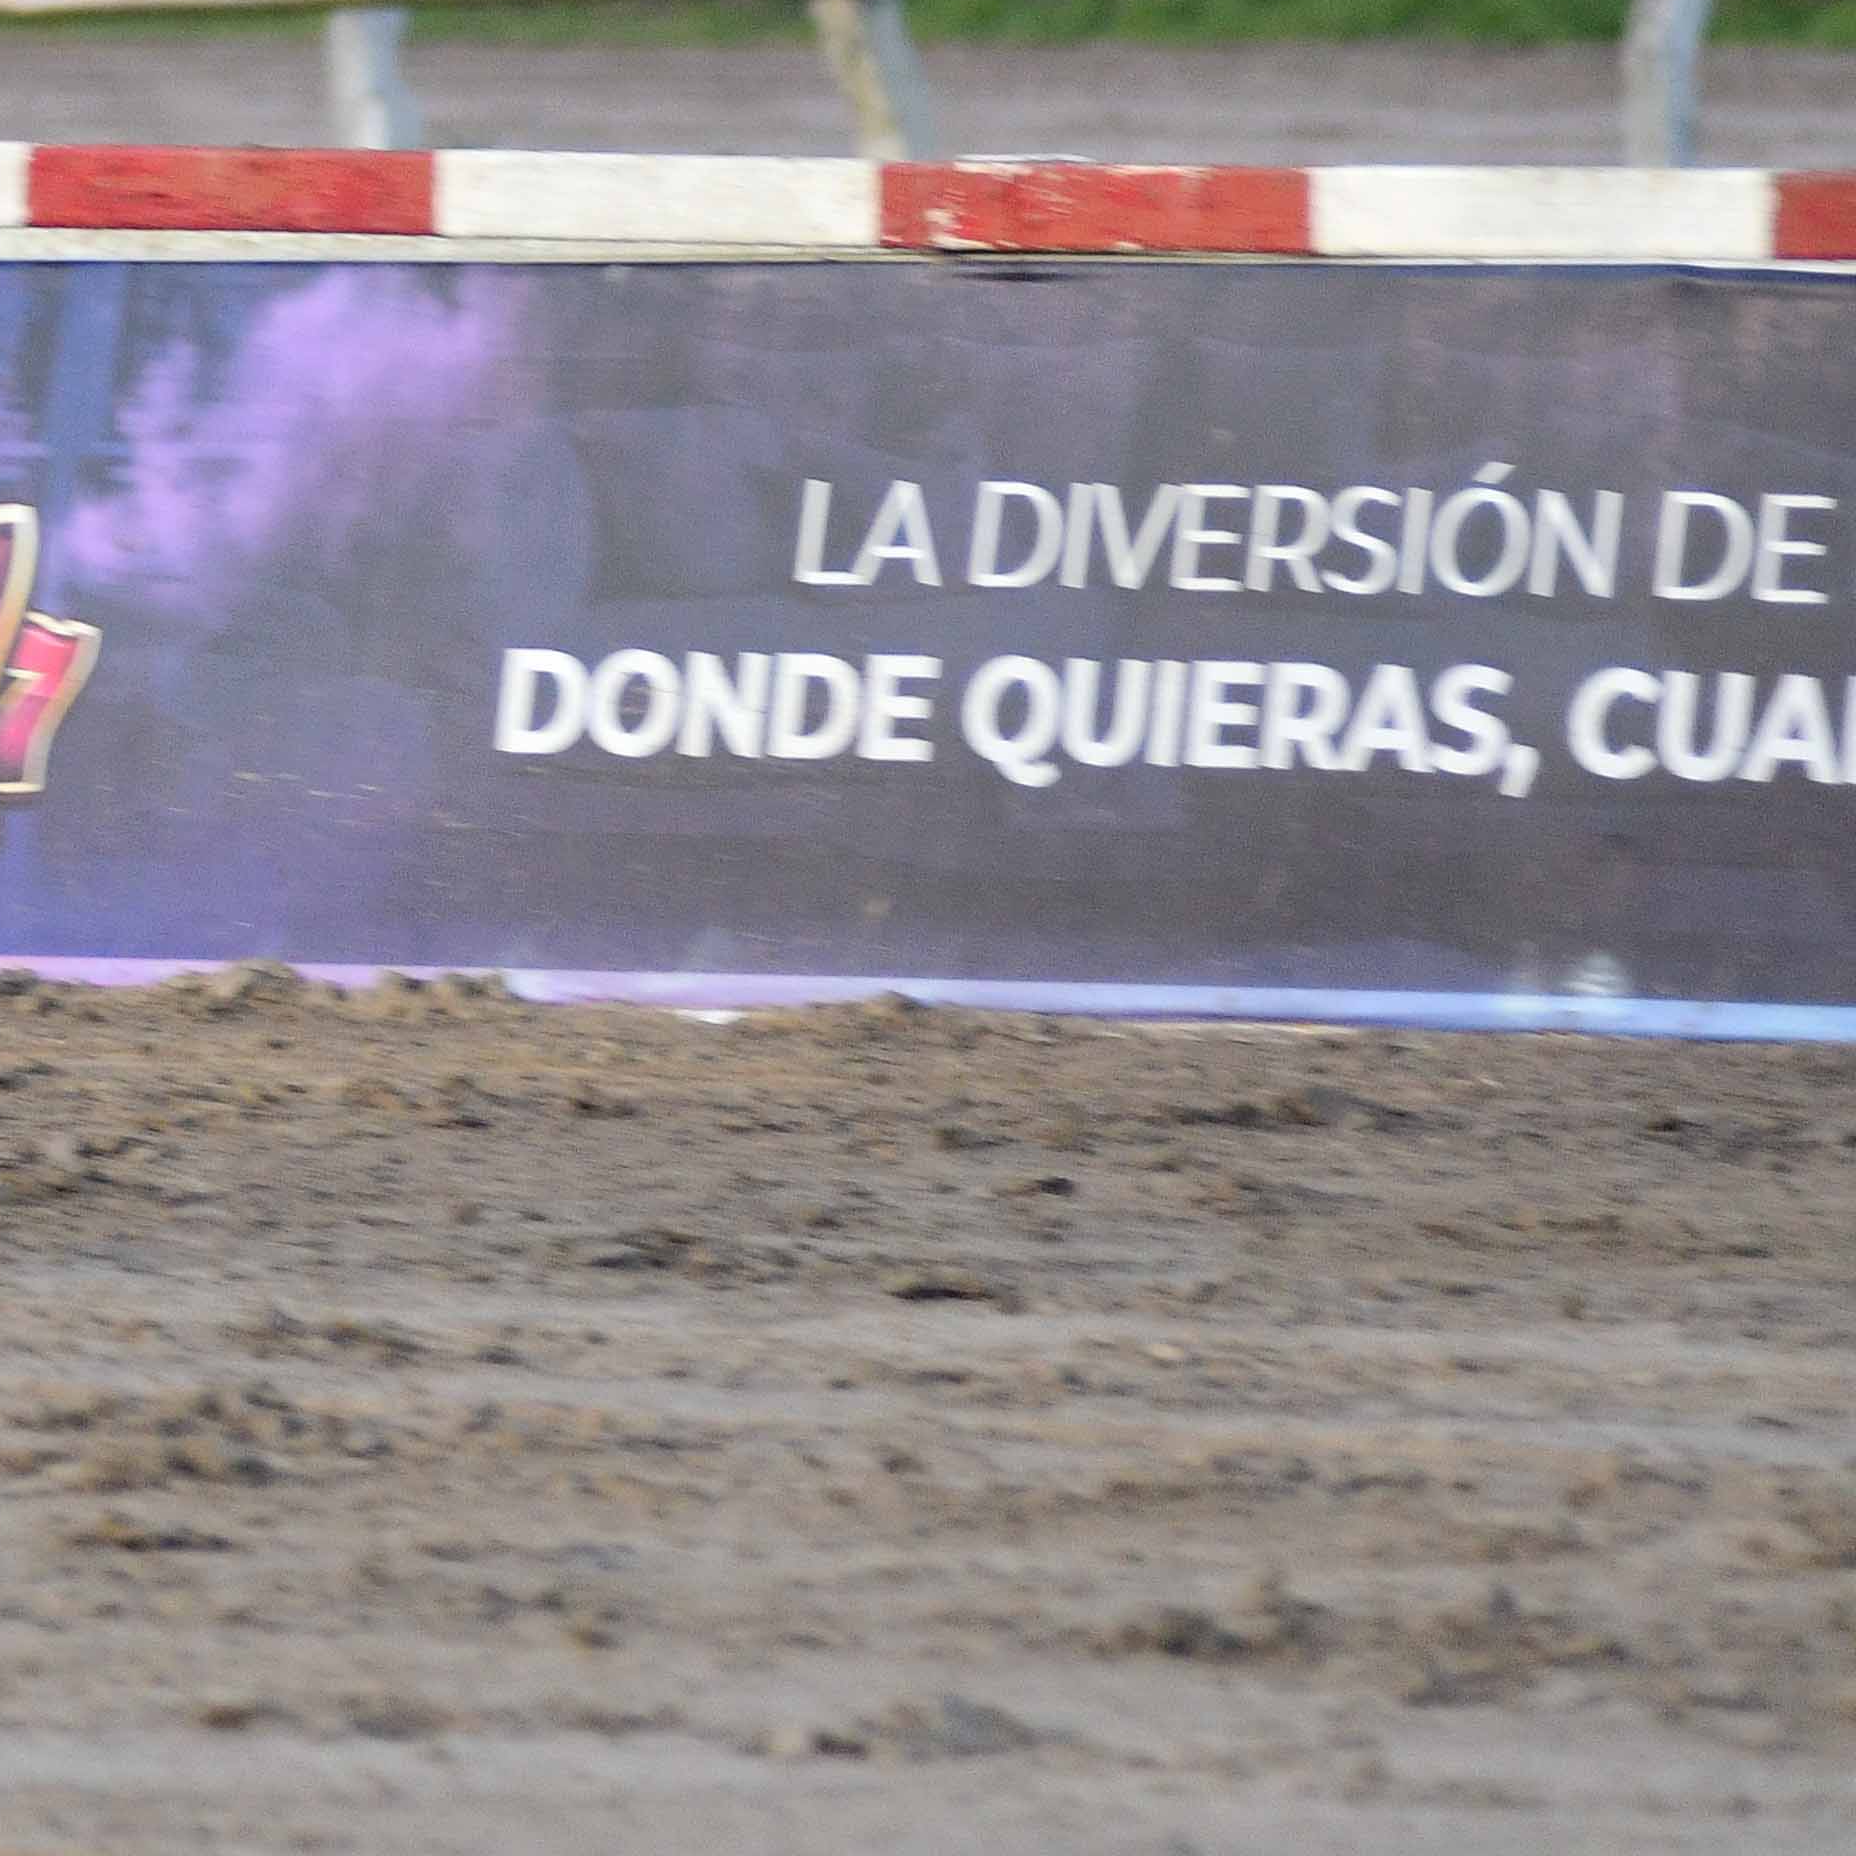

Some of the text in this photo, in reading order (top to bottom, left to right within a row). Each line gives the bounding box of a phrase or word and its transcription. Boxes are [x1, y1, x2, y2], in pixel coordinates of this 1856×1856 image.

[793, 461, 1837, 604] LA DIVERSIÓN DE
[493, 647, 1856, 798] DONDE QUIERAS, CUA
